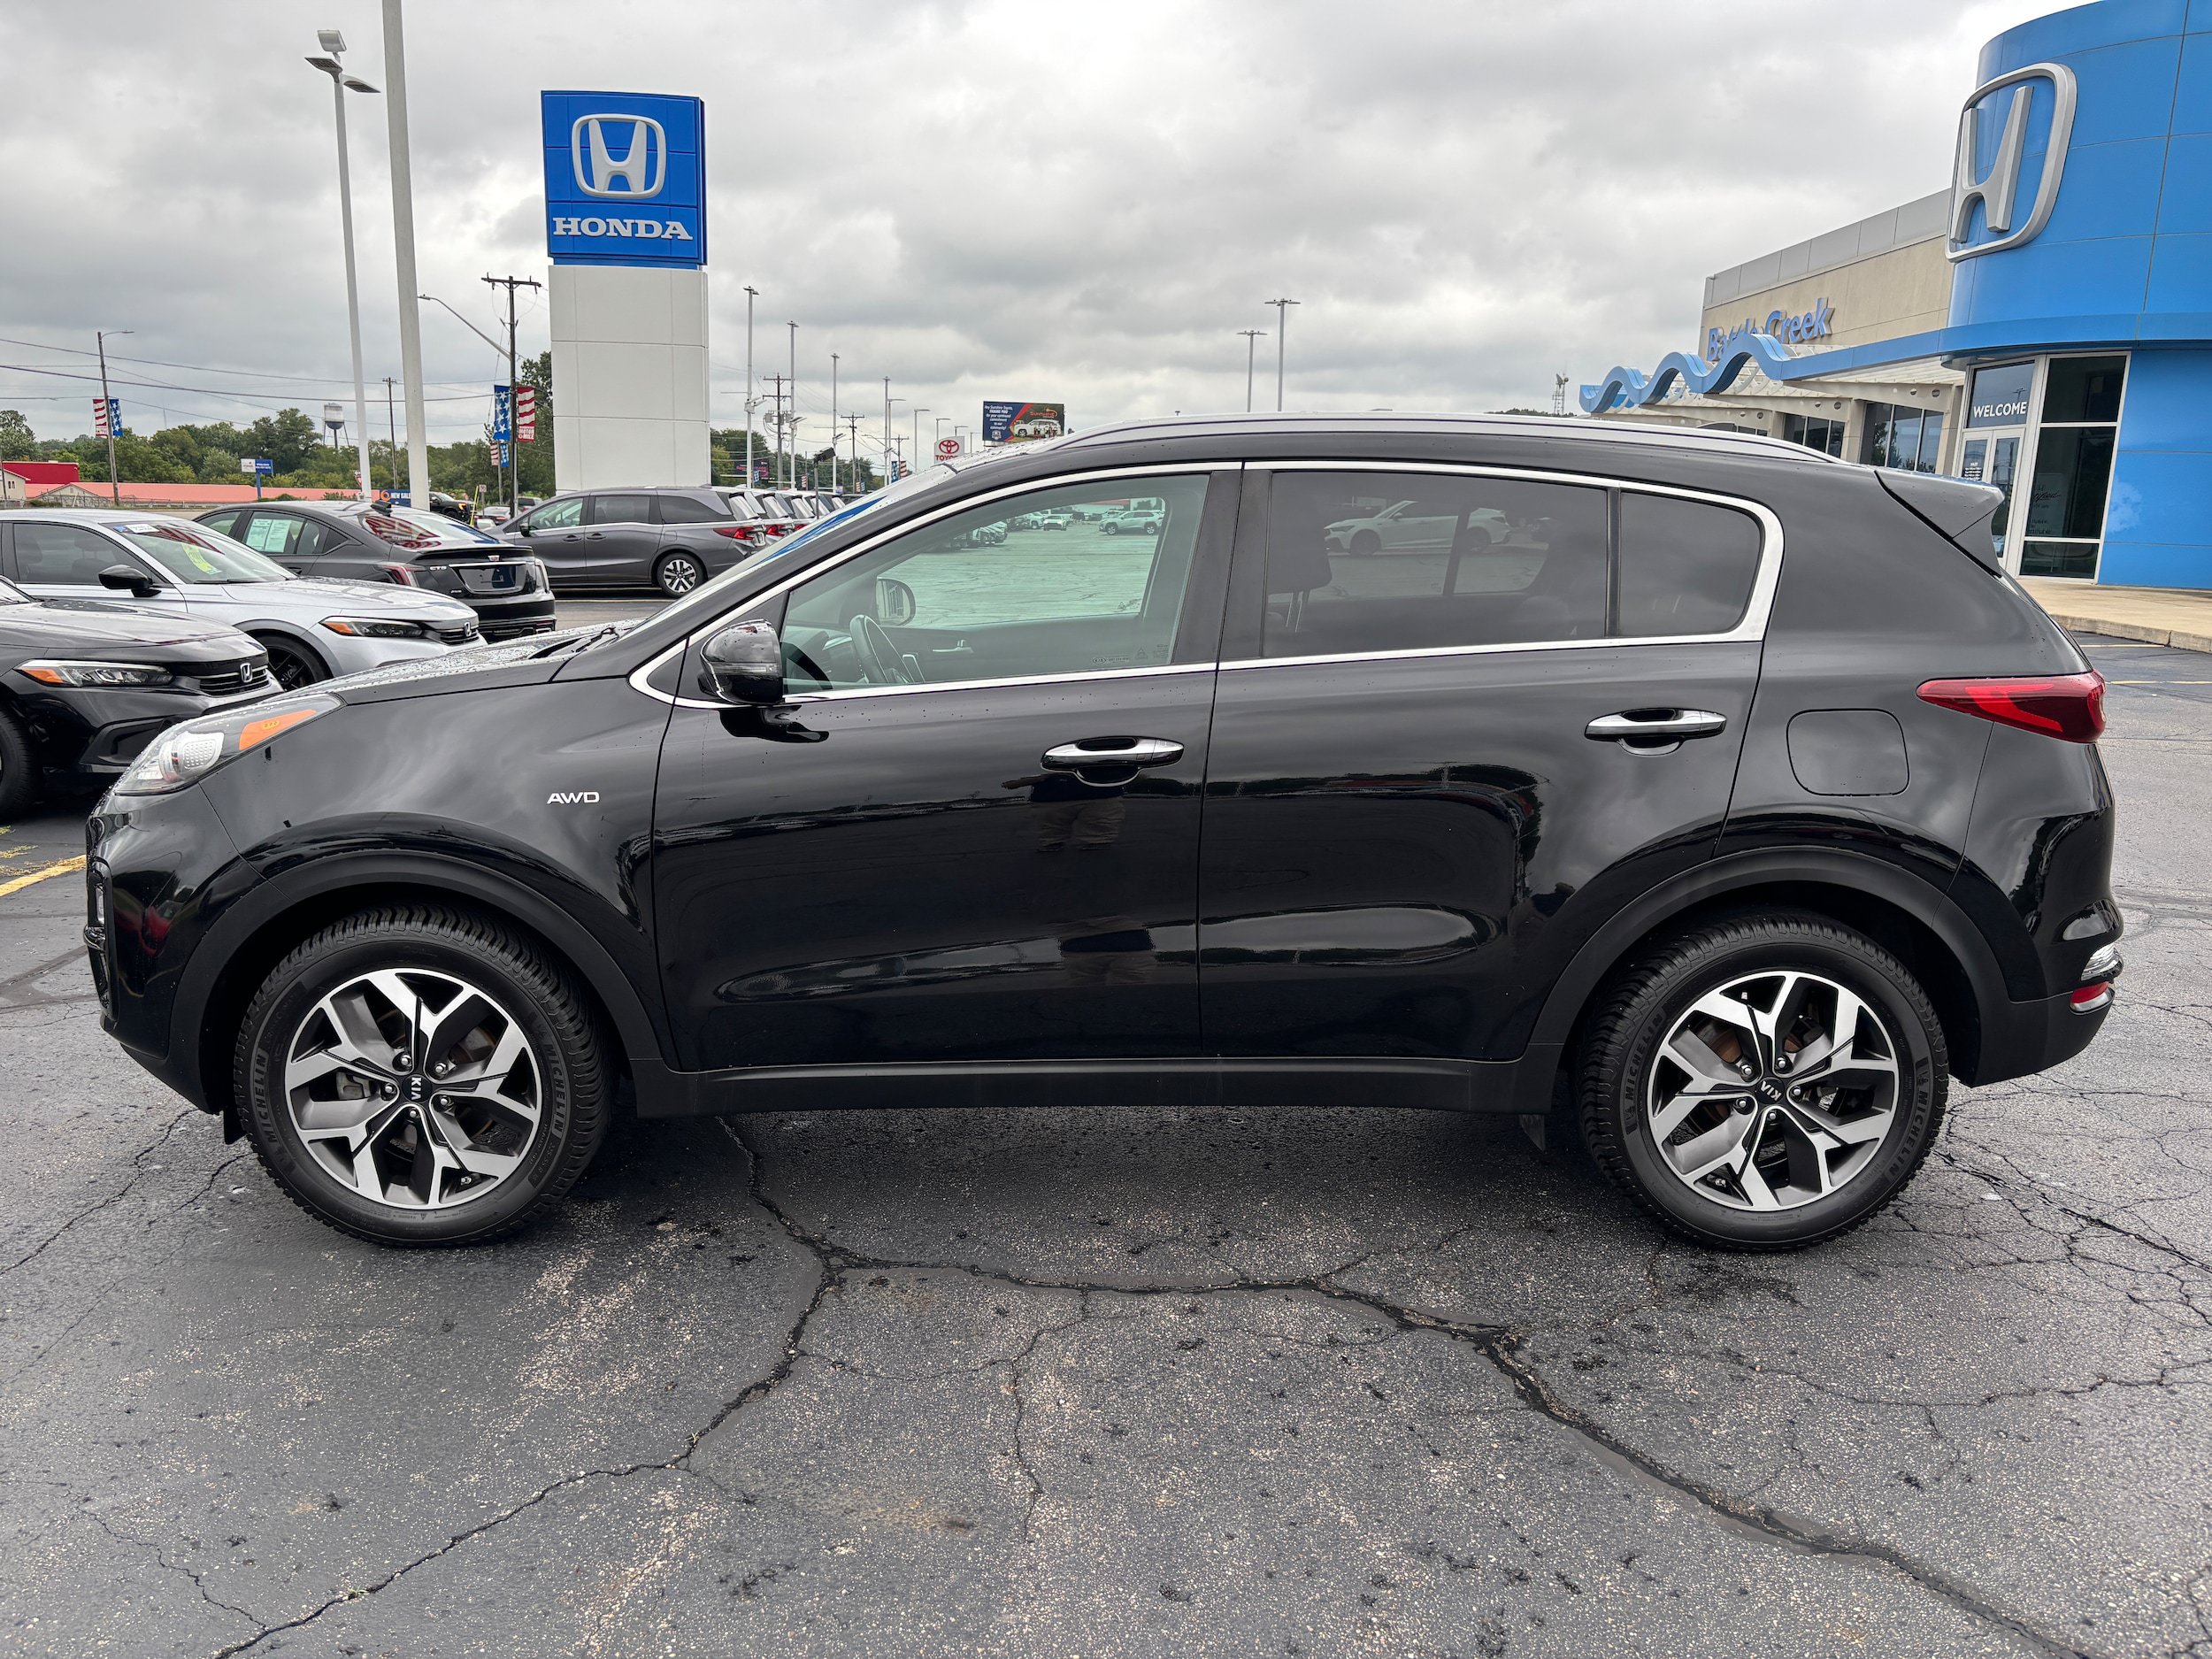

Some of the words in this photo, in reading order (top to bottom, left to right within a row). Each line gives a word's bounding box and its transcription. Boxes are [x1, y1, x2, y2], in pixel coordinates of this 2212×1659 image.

[552, 217, 694, 241] HONDA
[1764, 296, 1835, 344] Creek
[1973, 401, 2028, 419] WELCOME
[546, 791, 601, 804] AWD
[1624, 1013, 1663, 1101] MICHELIN
[253, 1053, 279, 1144] MICHELIN
[411, 1077, 422, 1101] KIA
[546, 1043, 566, 1133] MICHELIN
[1761, 1080, 1782, 1101] KIA
[1888, 1090, 1929, 1178] MICHELIN
